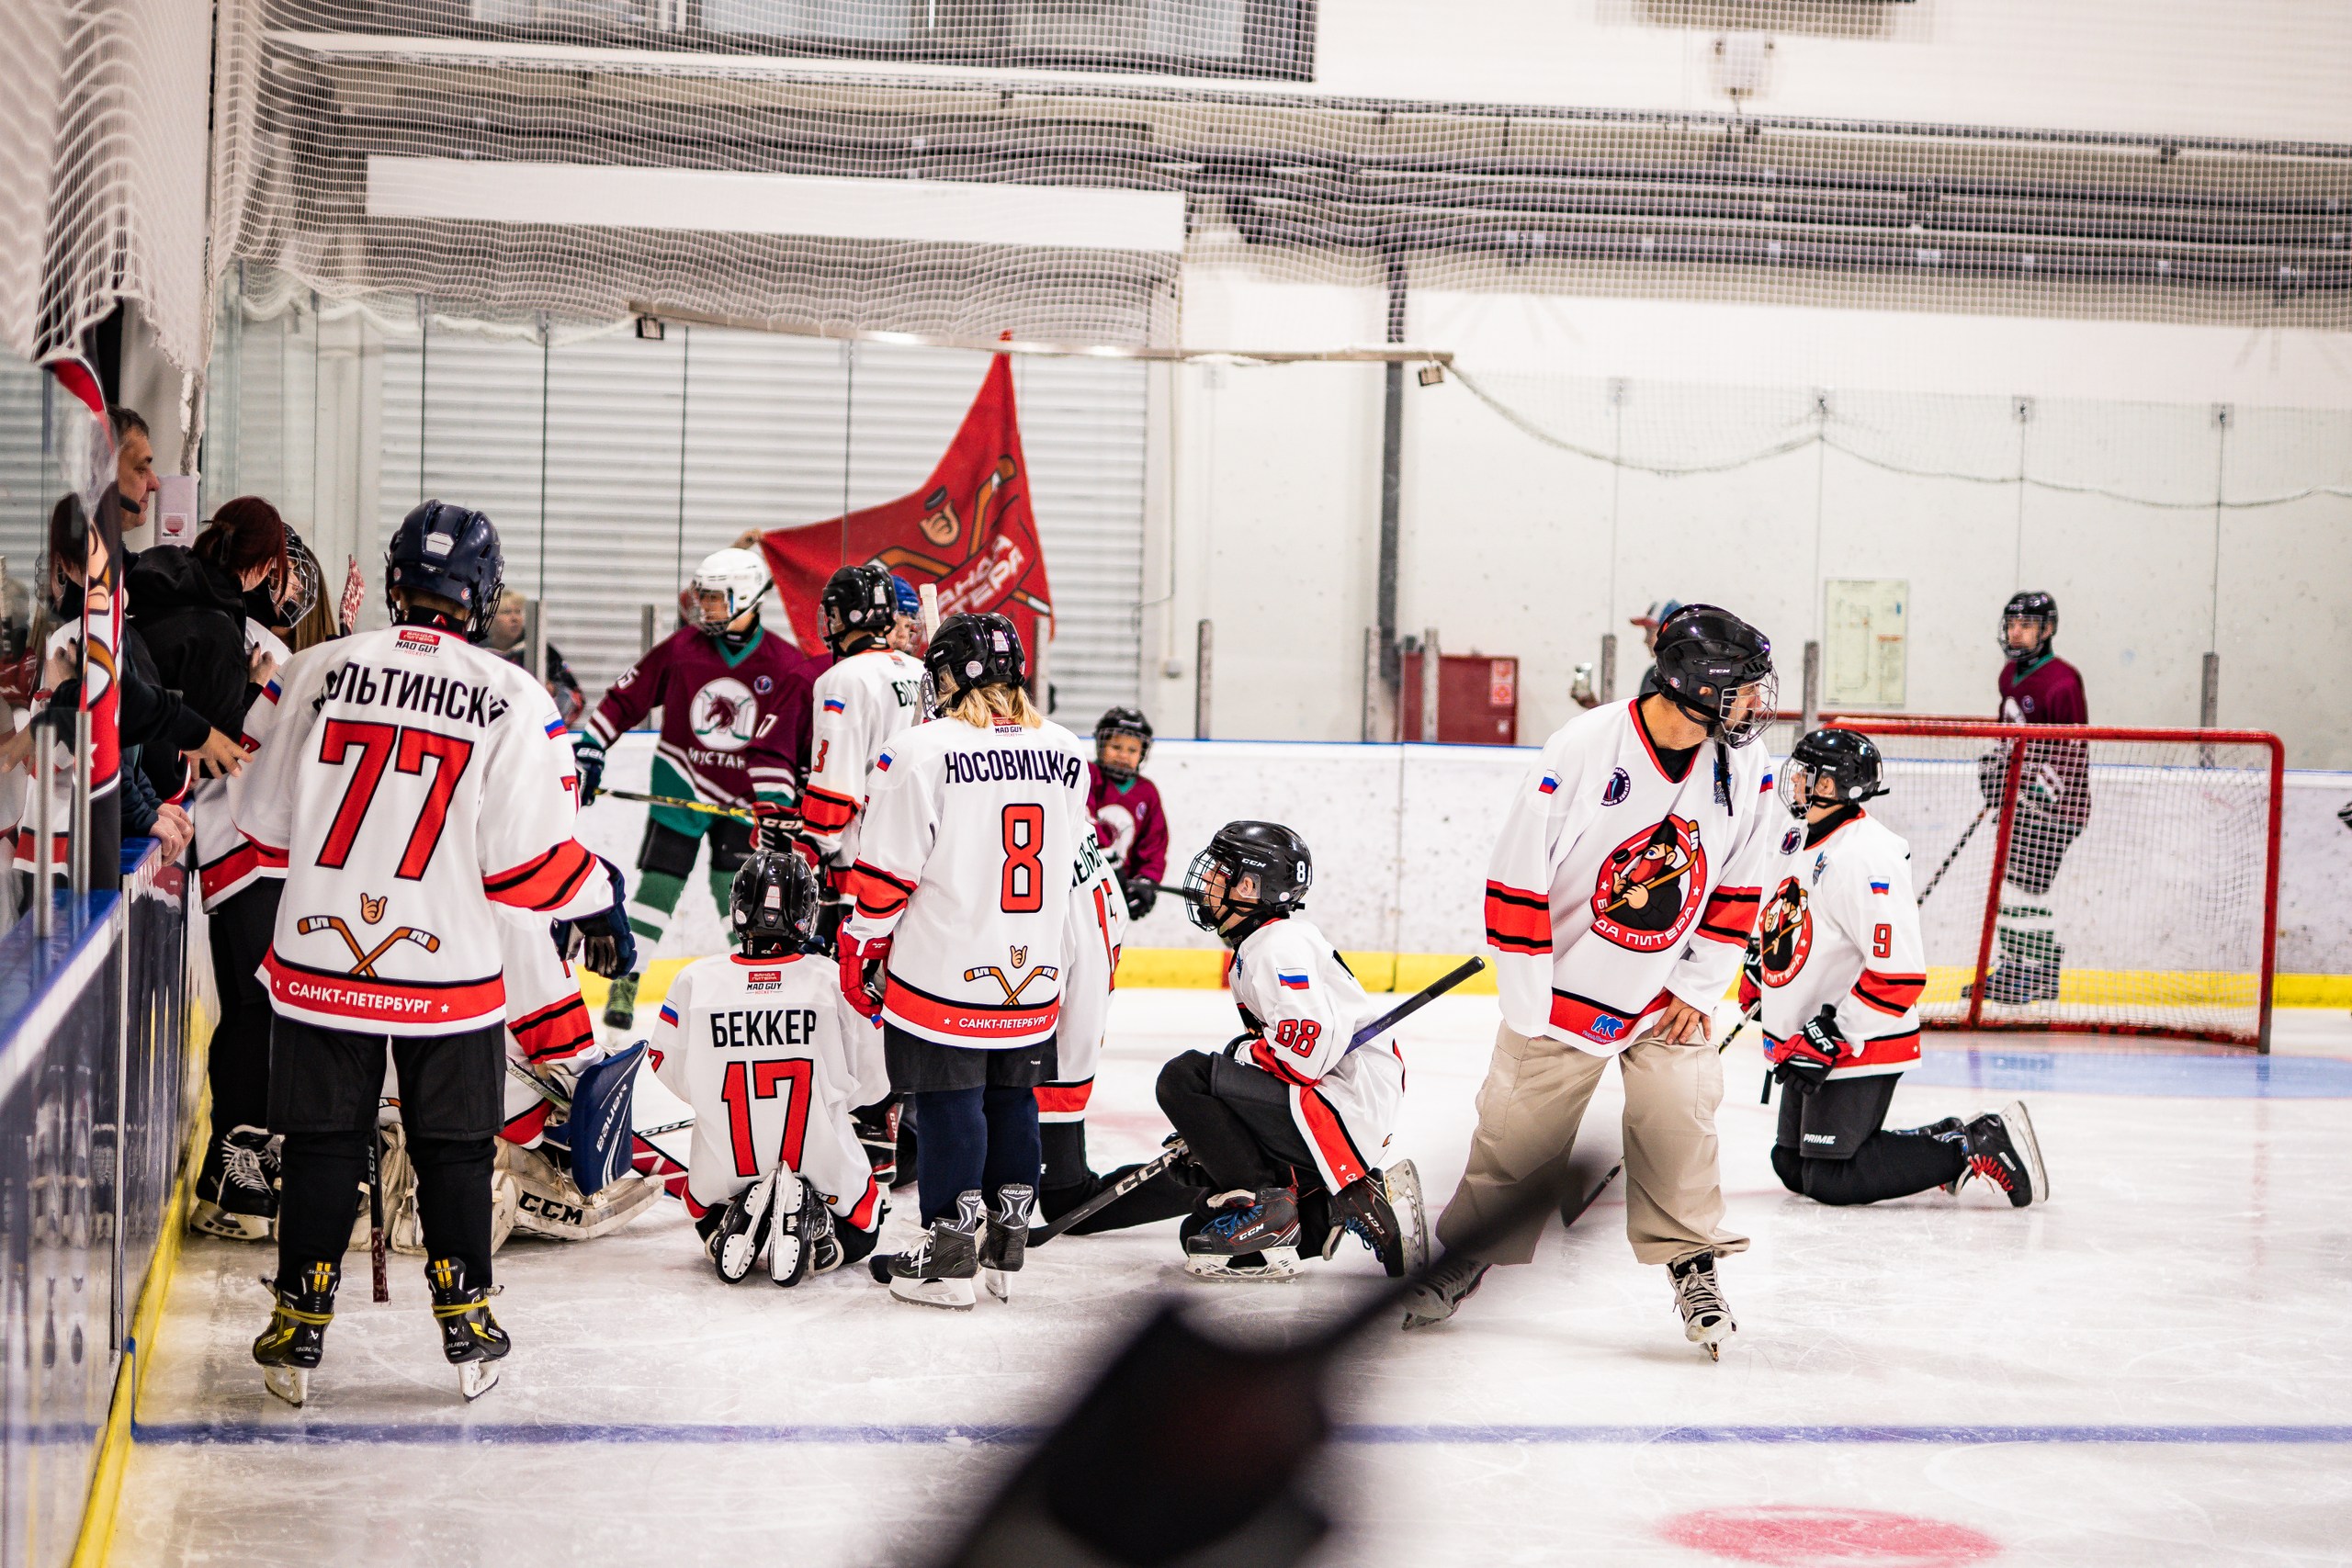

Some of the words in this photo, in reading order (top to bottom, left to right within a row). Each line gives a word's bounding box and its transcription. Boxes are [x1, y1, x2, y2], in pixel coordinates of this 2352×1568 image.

[395, 640, 418, 650] MAD
[418, 644, 439, 654] GUY
[314, 716, 475, 882] 77
[1001, 803, 1045, 914] 8
[1241, 857, 1267, 868] CCM
[1625, 906, 1694, 946] ПИТЕРА
[1872, 923, 1893, 958] 9
[746, 982, 765, 991] MAD
[765, 982, 782, 990] GUY
[1766, 953, 1804, 985] ПИТЕРА
[288, 981, 432, 1013] САНКТ-ПЕТЕРБУРГ
[710, 1009, 817, 1048] БЕККЕР
[958, 1015, 1048, 1030] САНКТ-ПЕТЕРБУРГ
[1275, 1018, 1322, 1058] 88
[595, 1082, 628, 1154] BAUER
[721, 1057, 814, 1178] 17
[1803, 1133, 1837, 1145] PRIME
[368, 1145, 377, 1186] CCM
[519, 1189, 583, 1225] CCM
[1364, 1212, 1386, 1235] CCM
[1238, 1223, 1265, 1241] CCM
